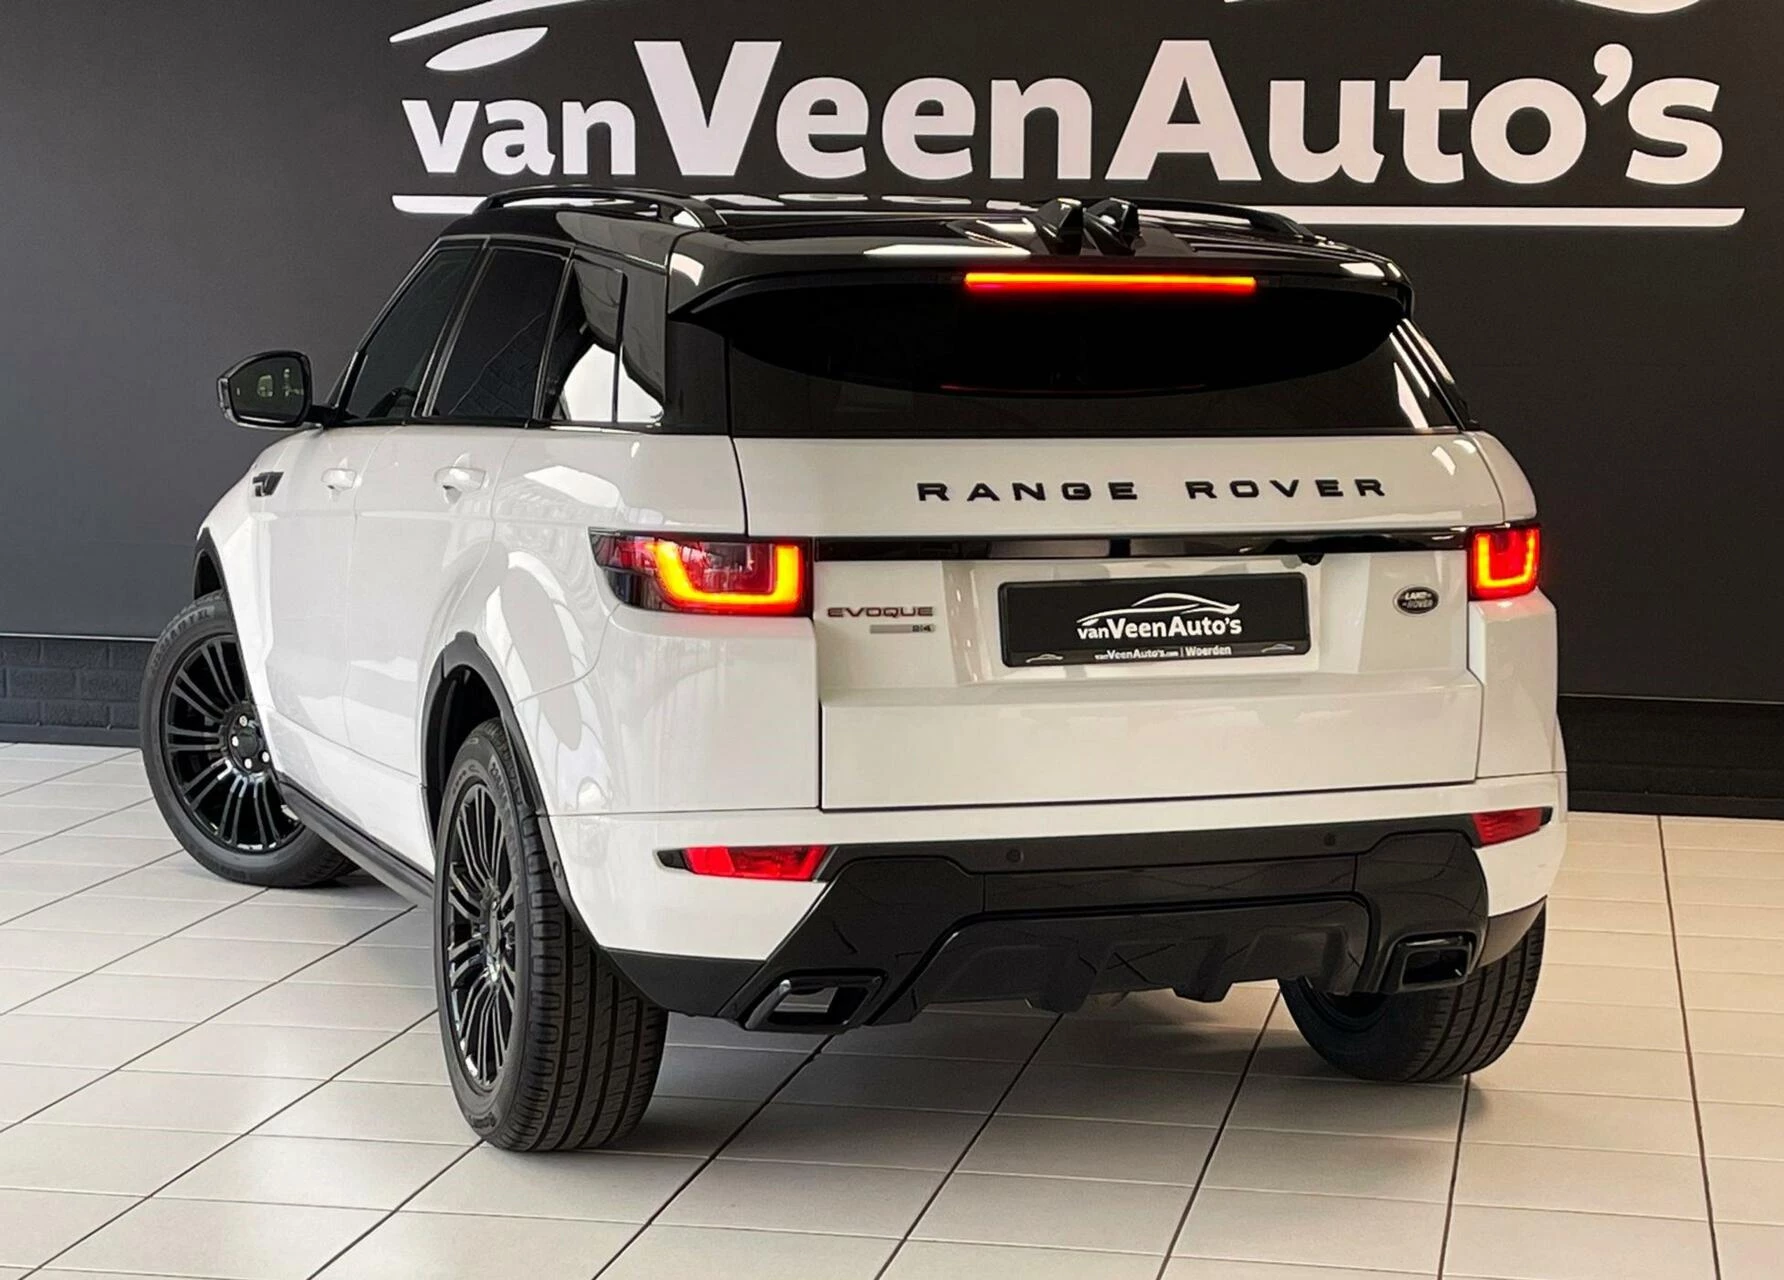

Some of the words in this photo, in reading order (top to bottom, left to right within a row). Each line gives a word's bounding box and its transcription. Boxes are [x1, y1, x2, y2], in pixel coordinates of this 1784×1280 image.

[401, 39, 1724, 185] vanVeenAuto's
[916, 482, 1138, 501] RANGE
[1185, 478, 1386, 499] ROVER
[826, 606, 934, 619] EVOQUE
[1077, 616, 1242, 640] vanVeenAuto's
[1185, 645, 1233, 657] Woerden
